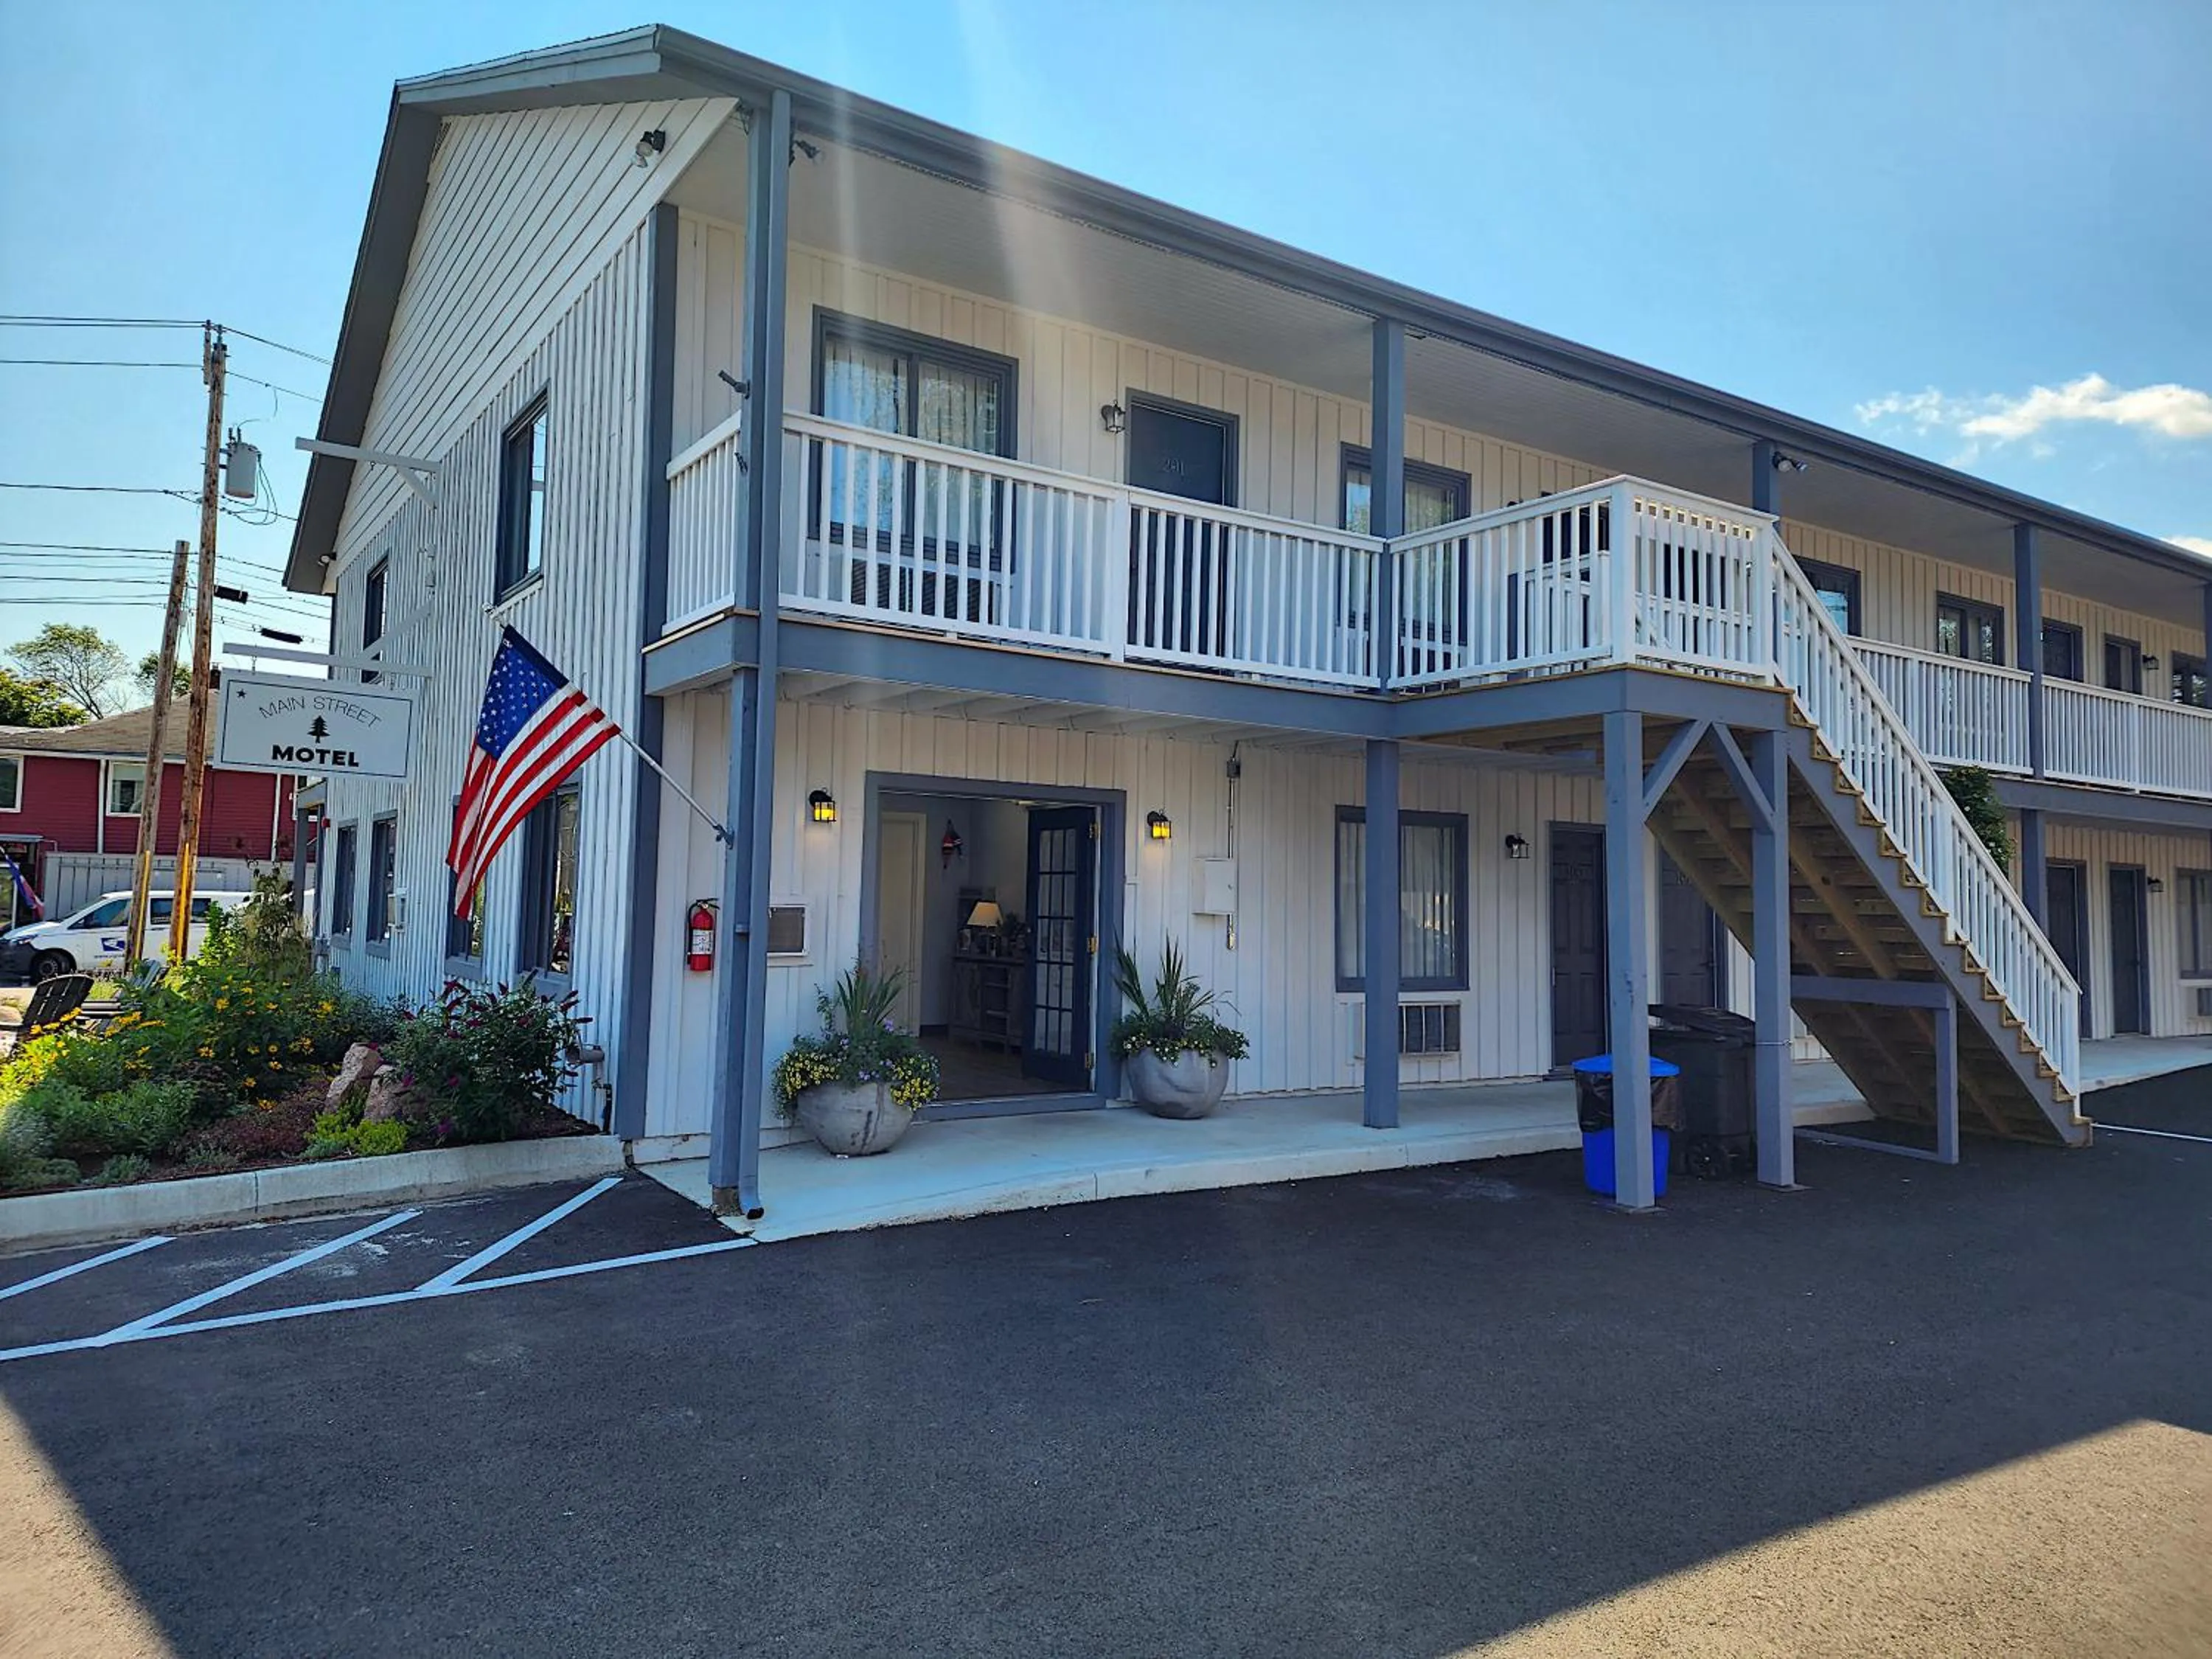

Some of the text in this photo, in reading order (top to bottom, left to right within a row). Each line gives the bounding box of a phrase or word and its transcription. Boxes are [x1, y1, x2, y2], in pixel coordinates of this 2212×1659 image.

[259, 695, 382, 728] MAIN STREET
[271, 745, 359, 768] MOTEL
